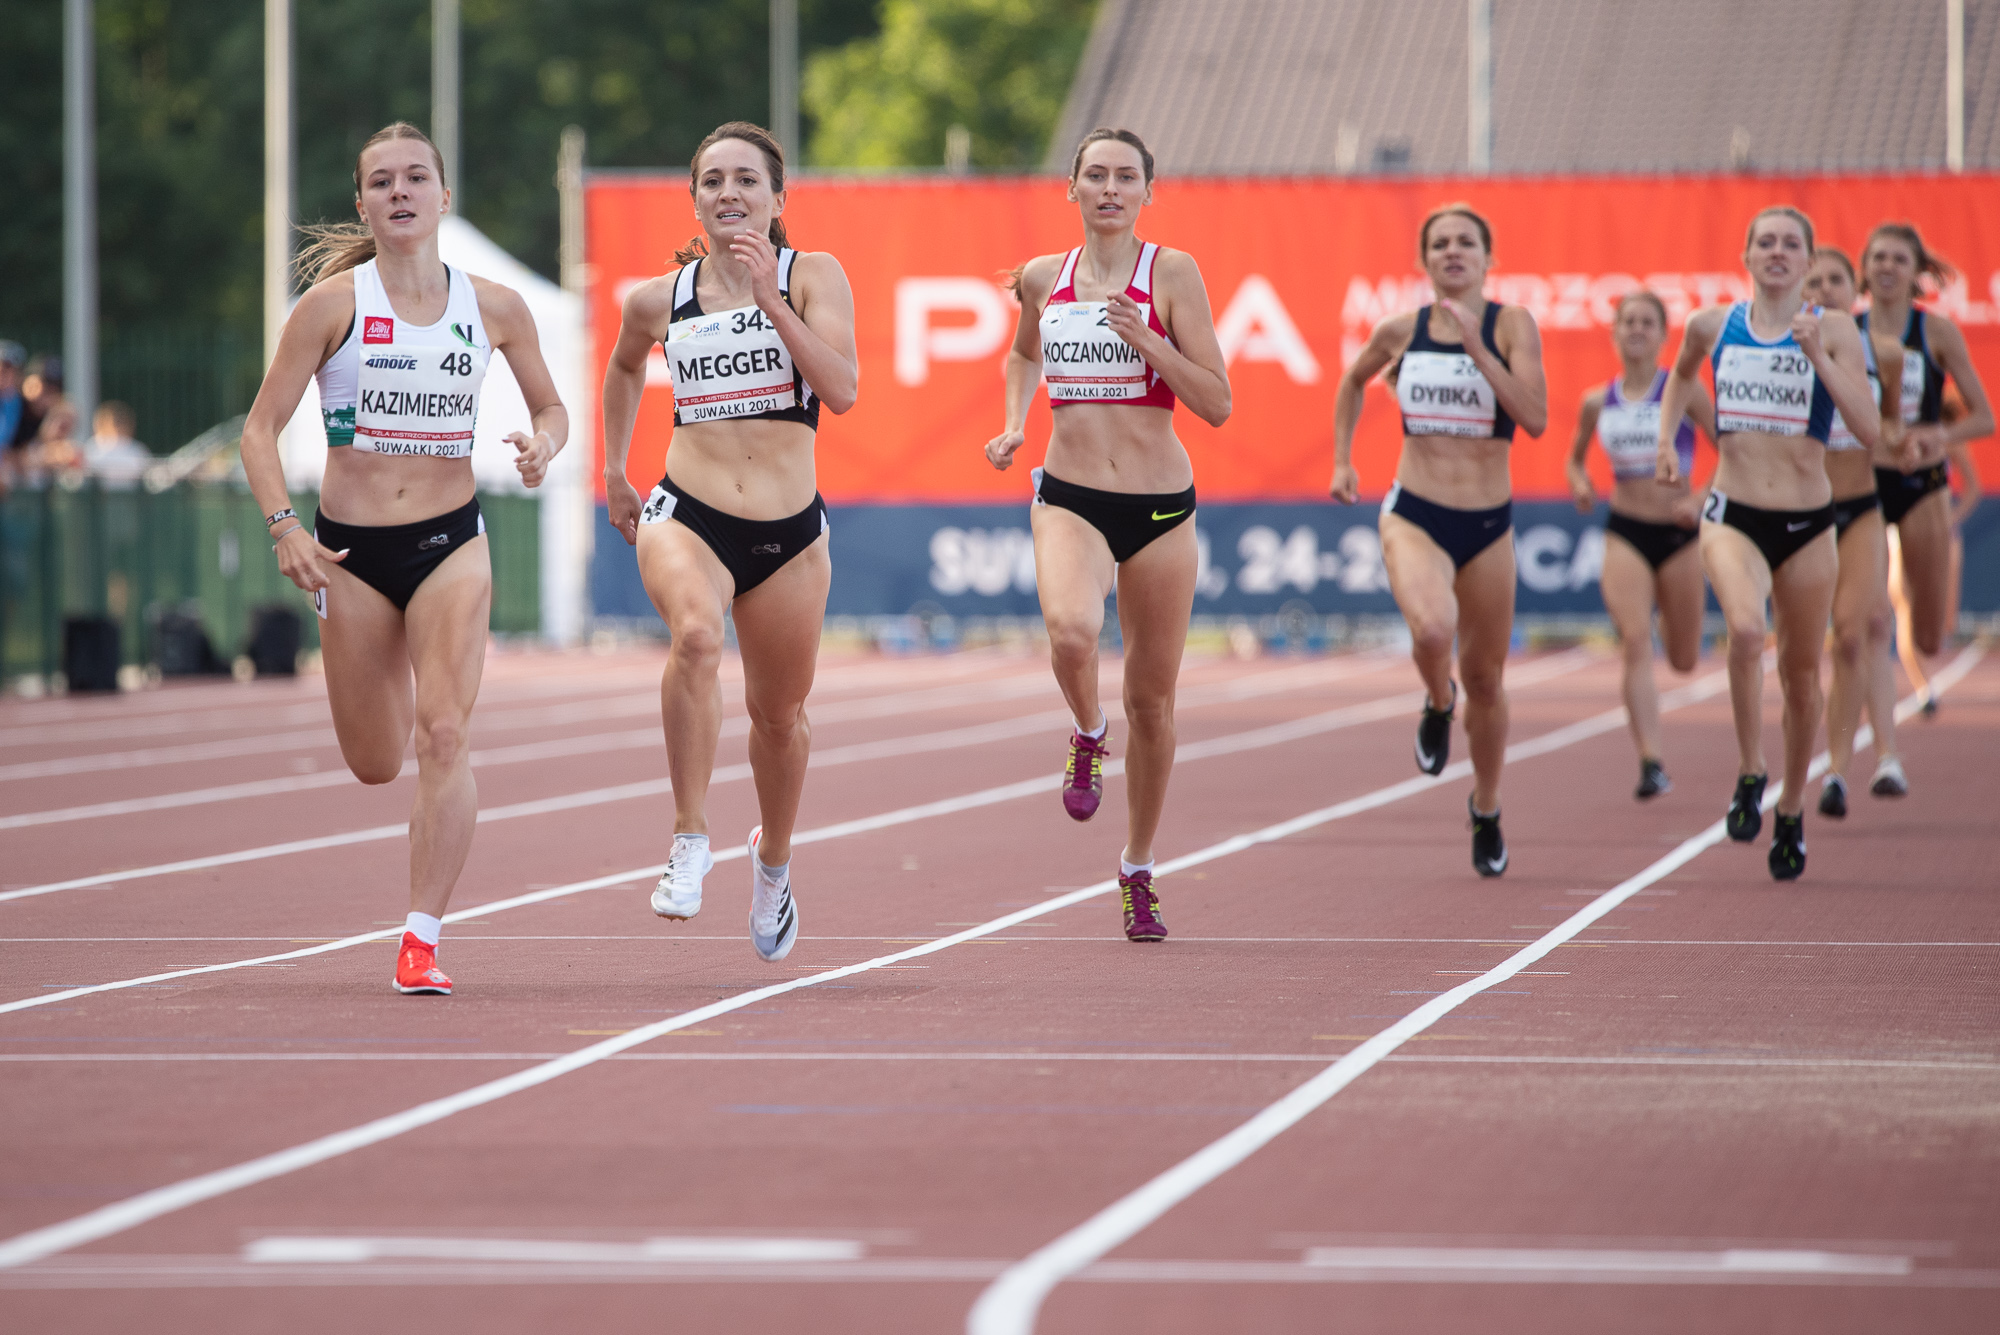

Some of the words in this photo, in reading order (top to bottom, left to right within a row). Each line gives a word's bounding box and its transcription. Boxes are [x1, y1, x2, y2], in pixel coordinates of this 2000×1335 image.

[895, 275, 1324, 389] PA
[1044, 342, 1142, 363] KOCZANOWA
[440, 352, 472, 377] 48
[677, 347, 784, 383] MEGGER
[1769, 354, 1809, 376] 220
[361, 389, 474, 418] KAZIMIERSKA
[704, 391, 753, 403] MISTRZOSTWA
[752, 388, 777, 396] POLSKI
[1057, 387, 1099, 397] SUWAŁKI
[1102, 387, 1128, 397] 2021
[1410, 384, 1481, 408] DYBKA
[1716, 379, 1807, 408] PŁOCIŃSKA
[694, 402, 745, 420] SUWAŁKI
[748, 398, 777, 413] 2021
[391, 431, 441, 440] MISTRZOSTWA
[374, 441, 431, 456] SUWAŁKI
[435, 444, 460, 456] 2021
[1705, 493, 1719, 522] 2
